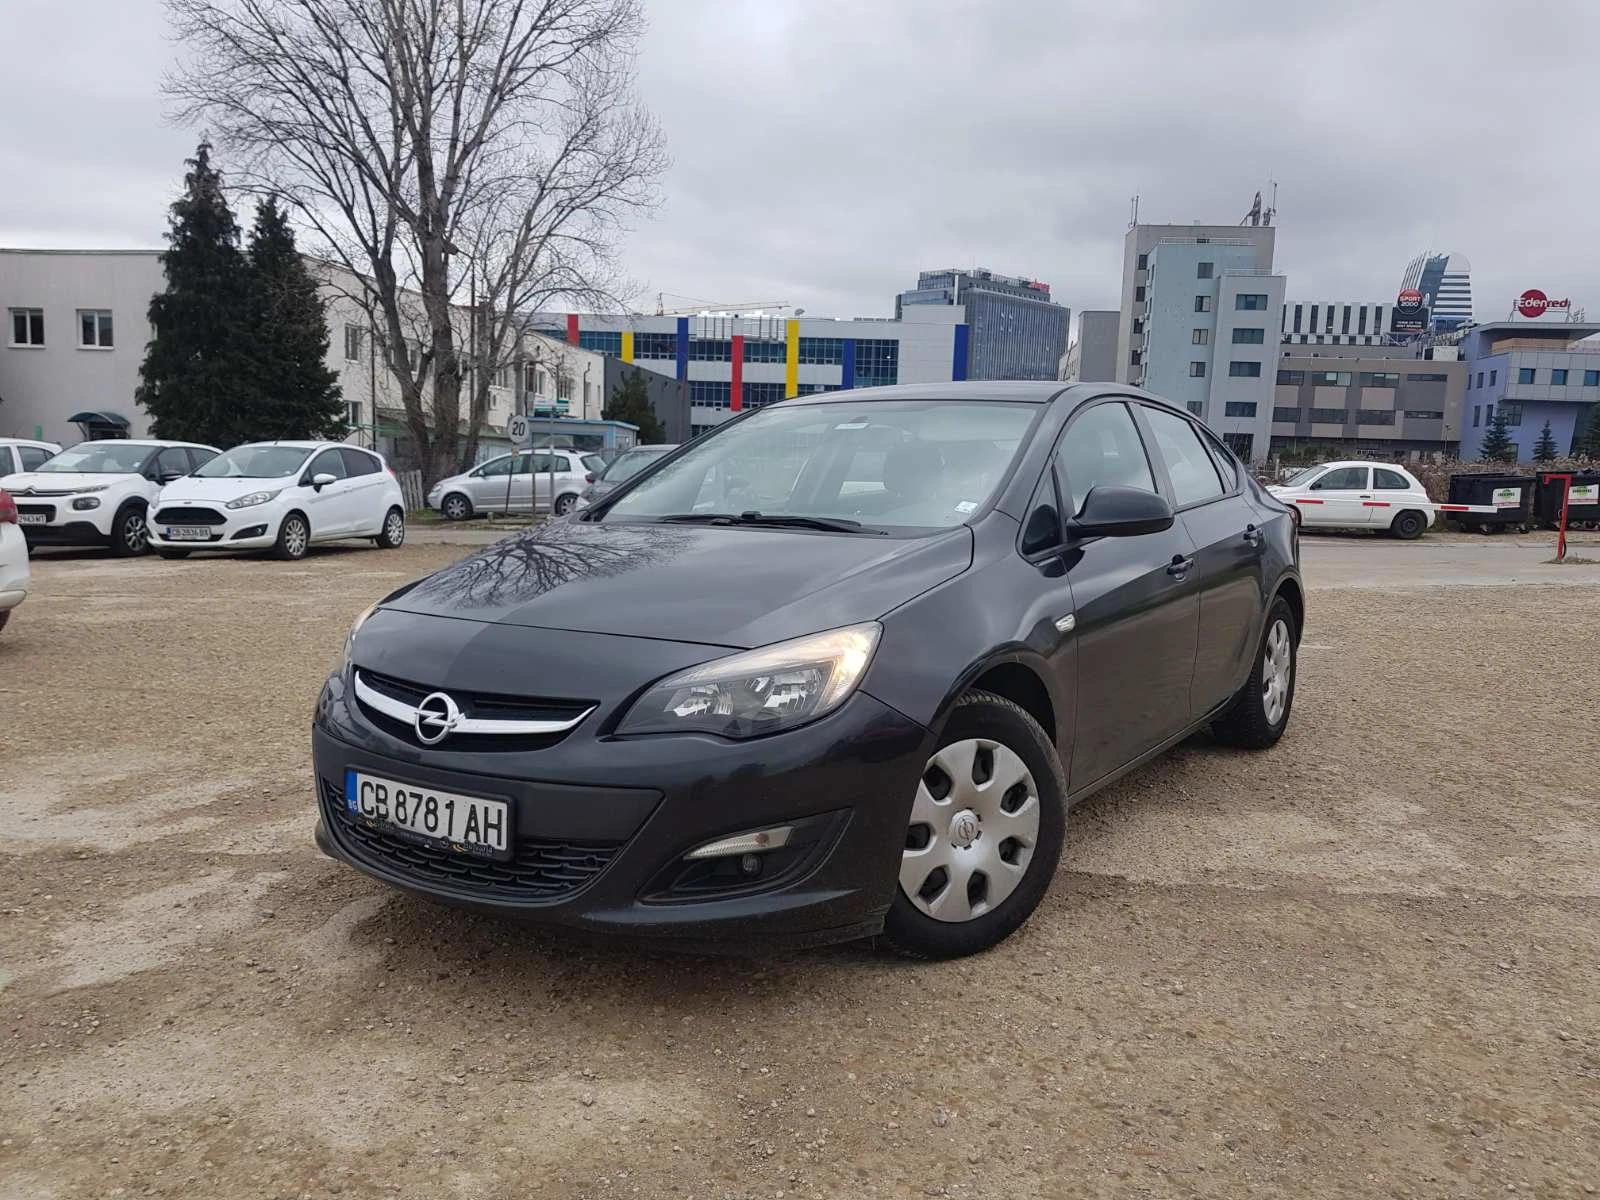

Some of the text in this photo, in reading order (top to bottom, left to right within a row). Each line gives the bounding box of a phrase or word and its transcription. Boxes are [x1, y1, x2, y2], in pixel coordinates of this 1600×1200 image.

[1519, 297, 1568, 308] Edenred
[512, 421, 526, 437] 20
[395, 789, 455, 837] 8781
